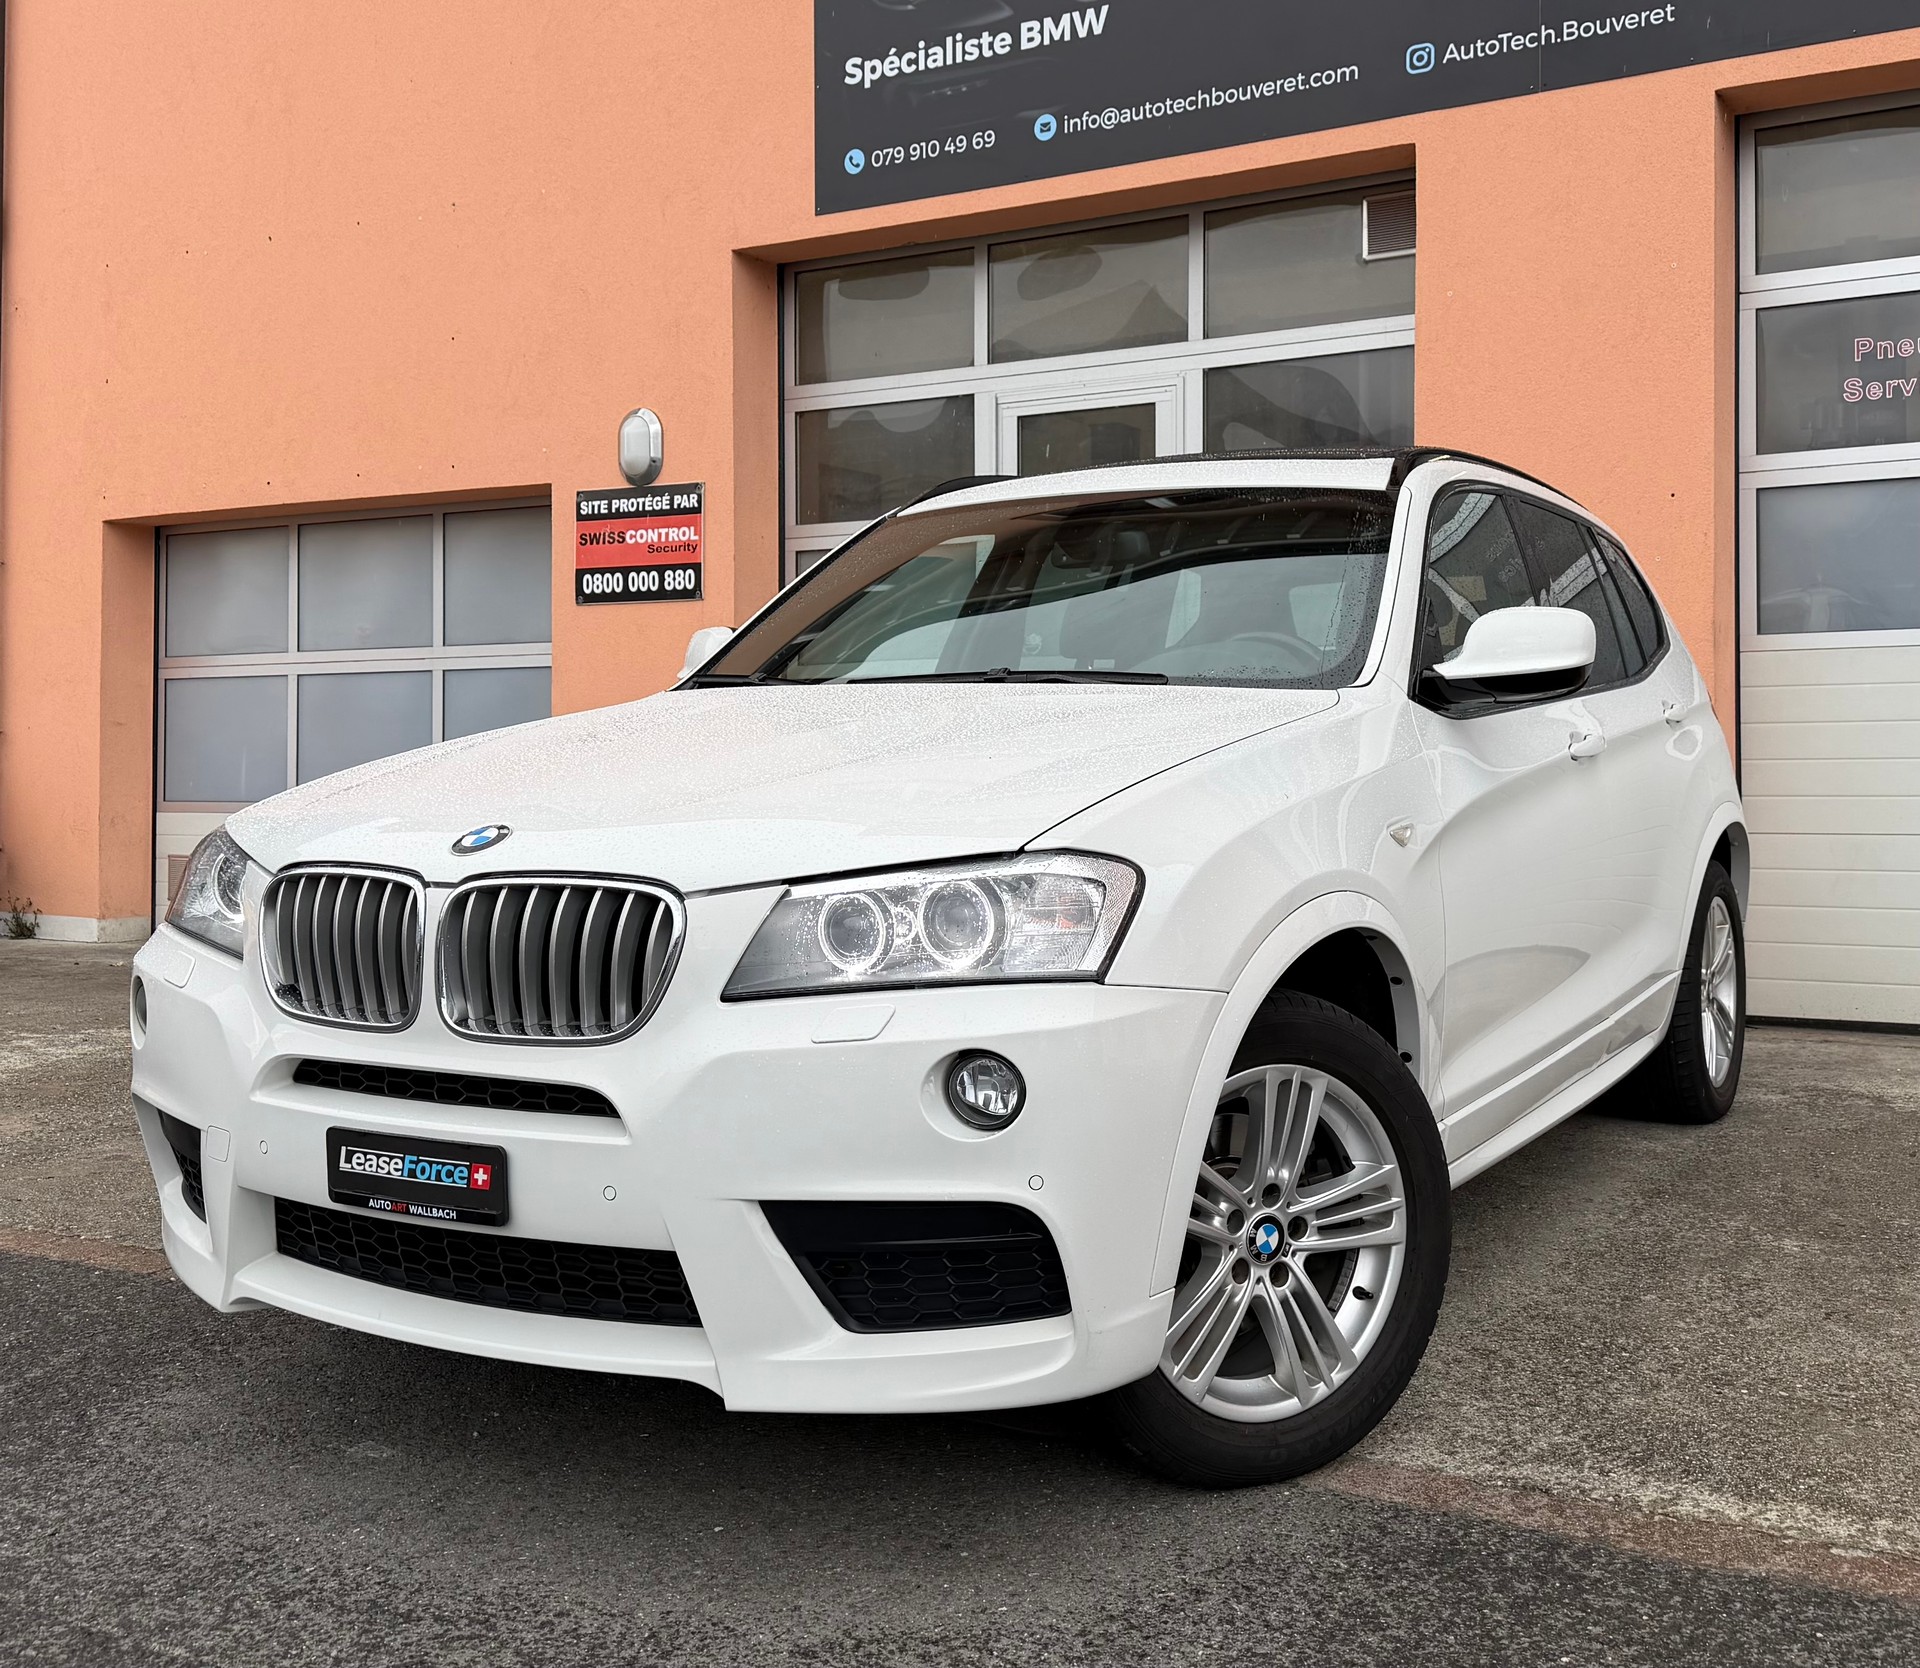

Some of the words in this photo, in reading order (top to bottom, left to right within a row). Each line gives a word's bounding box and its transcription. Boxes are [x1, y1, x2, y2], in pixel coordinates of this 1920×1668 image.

[1443, 4, 1675, 63] AutoTech.Bouveret
[845, 32, 1012, 88] Spécialiste
[1021, 5, 1109, 50] BMW
[1064, 66, 1359, 134] info@autotechbouveret.com
[872, 147, 904, 167] 079
[910, 140, 939, 160] 910
[945, 135, 967, 154] 49
[972, 130, 995, 150] 69
[1854, 337, 1920, 362] Pne
[580, 500, 608, 515] SITE
[612, 493, 670, 513] PROTÉGÉ
[674, 494, 698, 509] PAR
[579, 526, 699, 546] SWISSCONTROL
[647, 542, 698, 554] Security
[583, 572, 623, 594] 0800
[628, 571, 659, 592] 000
[664, 569, 695, 590] 880
[339, 1146, 468, 1185] LeaseForce
[368, 1198, 408, 1212] AUTOART
[409, 1205, 457, 1220] WALLBACH
